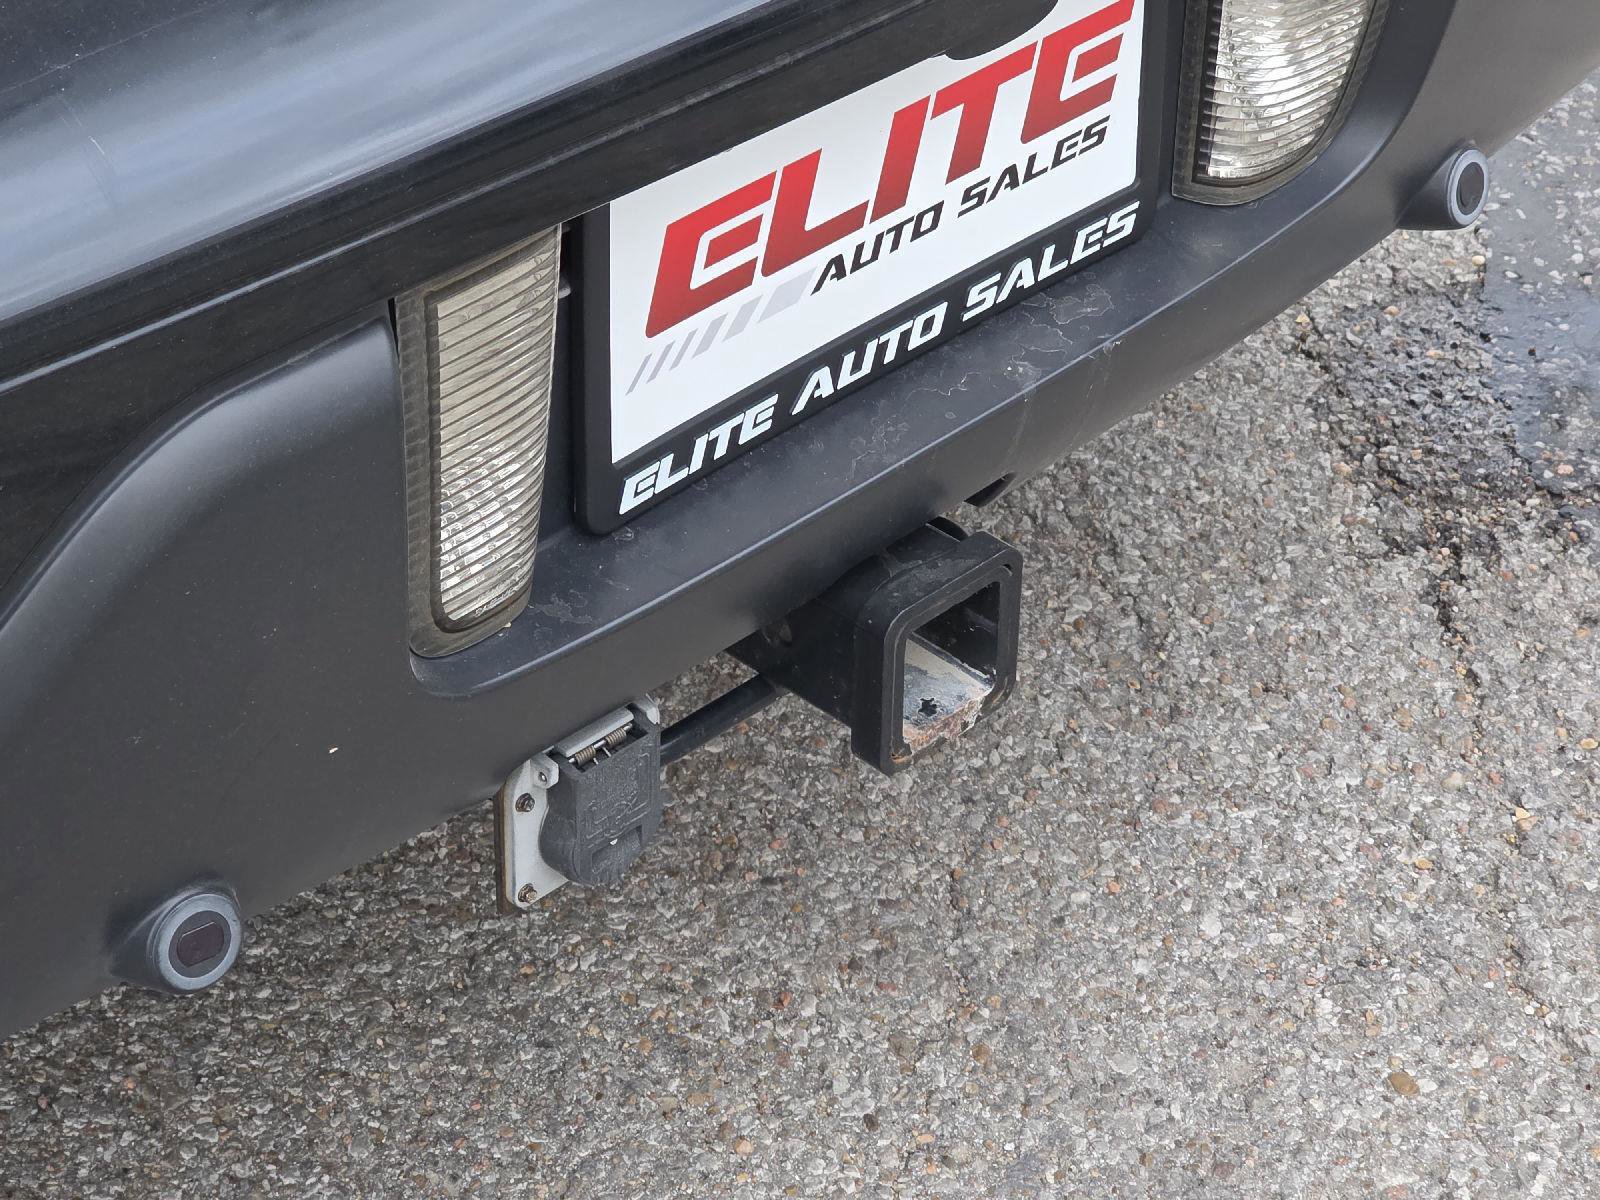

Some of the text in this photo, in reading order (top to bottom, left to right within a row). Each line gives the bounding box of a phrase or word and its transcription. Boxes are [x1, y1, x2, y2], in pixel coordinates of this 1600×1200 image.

[645, 0, 1135, 338] ELITE
[810, 115, 1110, 295] AUTO SALES
[619, 201, 1140, 515] ELITE AUTO SALES
